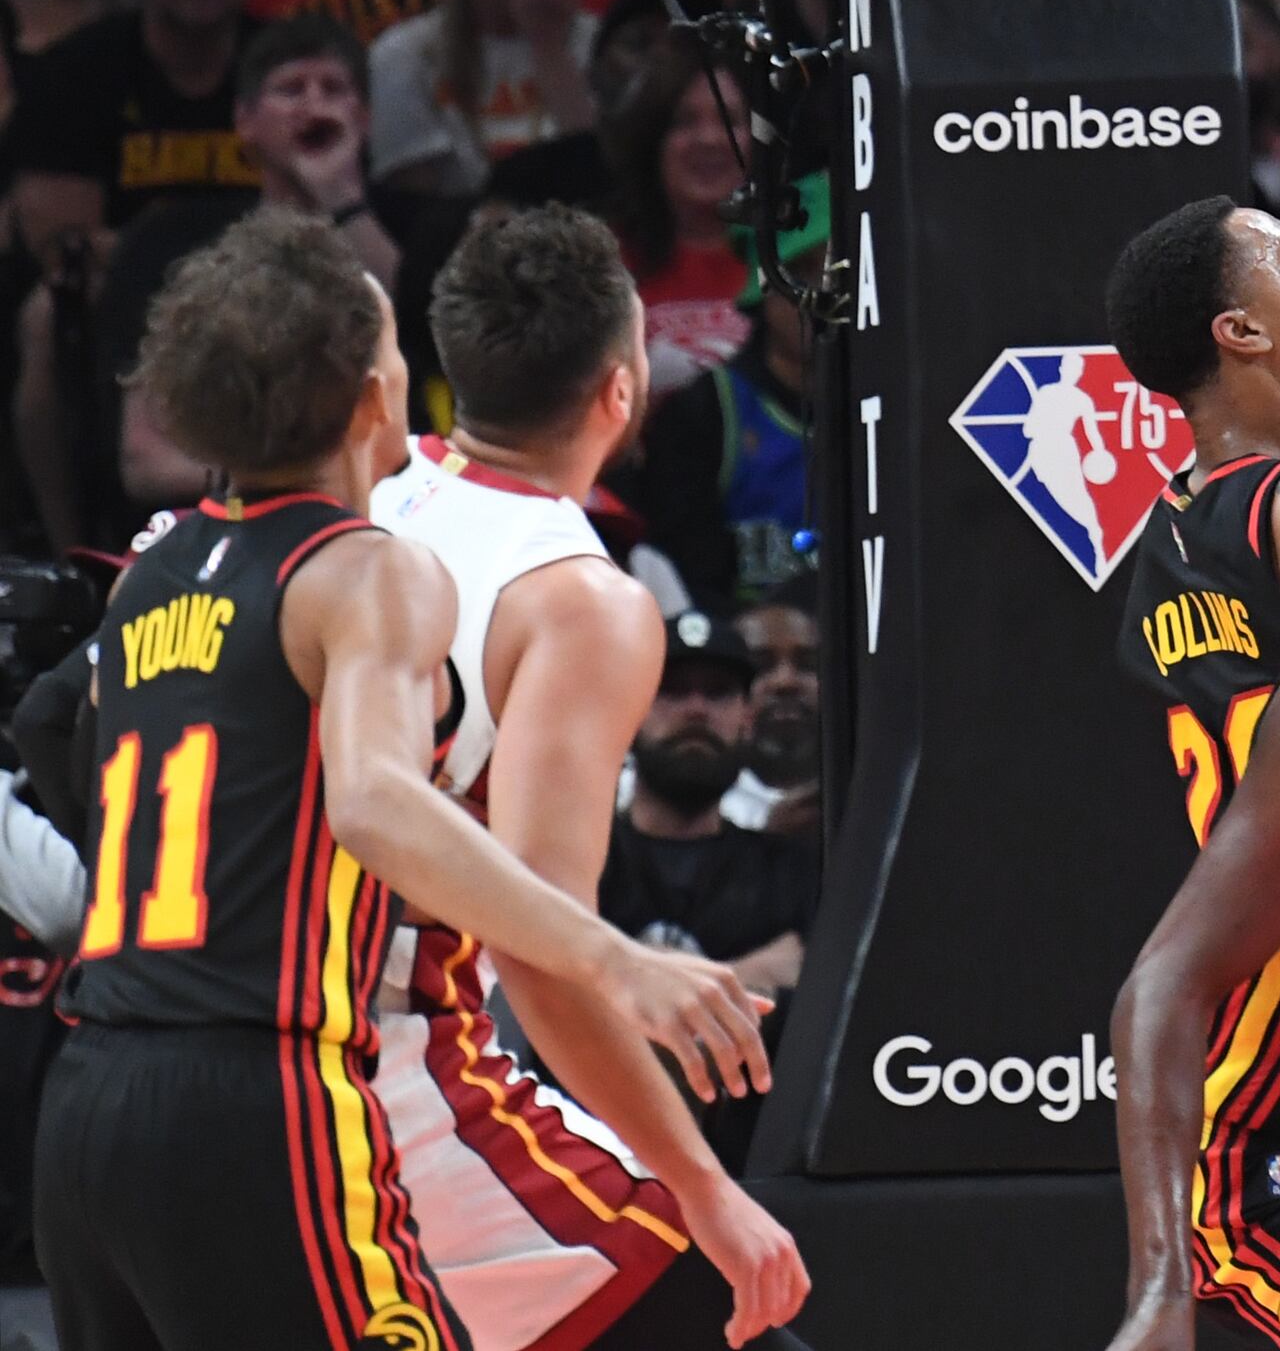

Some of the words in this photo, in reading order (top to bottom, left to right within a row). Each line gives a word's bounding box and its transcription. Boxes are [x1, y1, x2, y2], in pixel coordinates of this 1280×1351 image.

[933, 95, 1223, 153] coinbase
[1114, 380, 1167, 450] 75
[121, 593, 235, 690] YOUNG
[79, 723, 218, 960] 11
